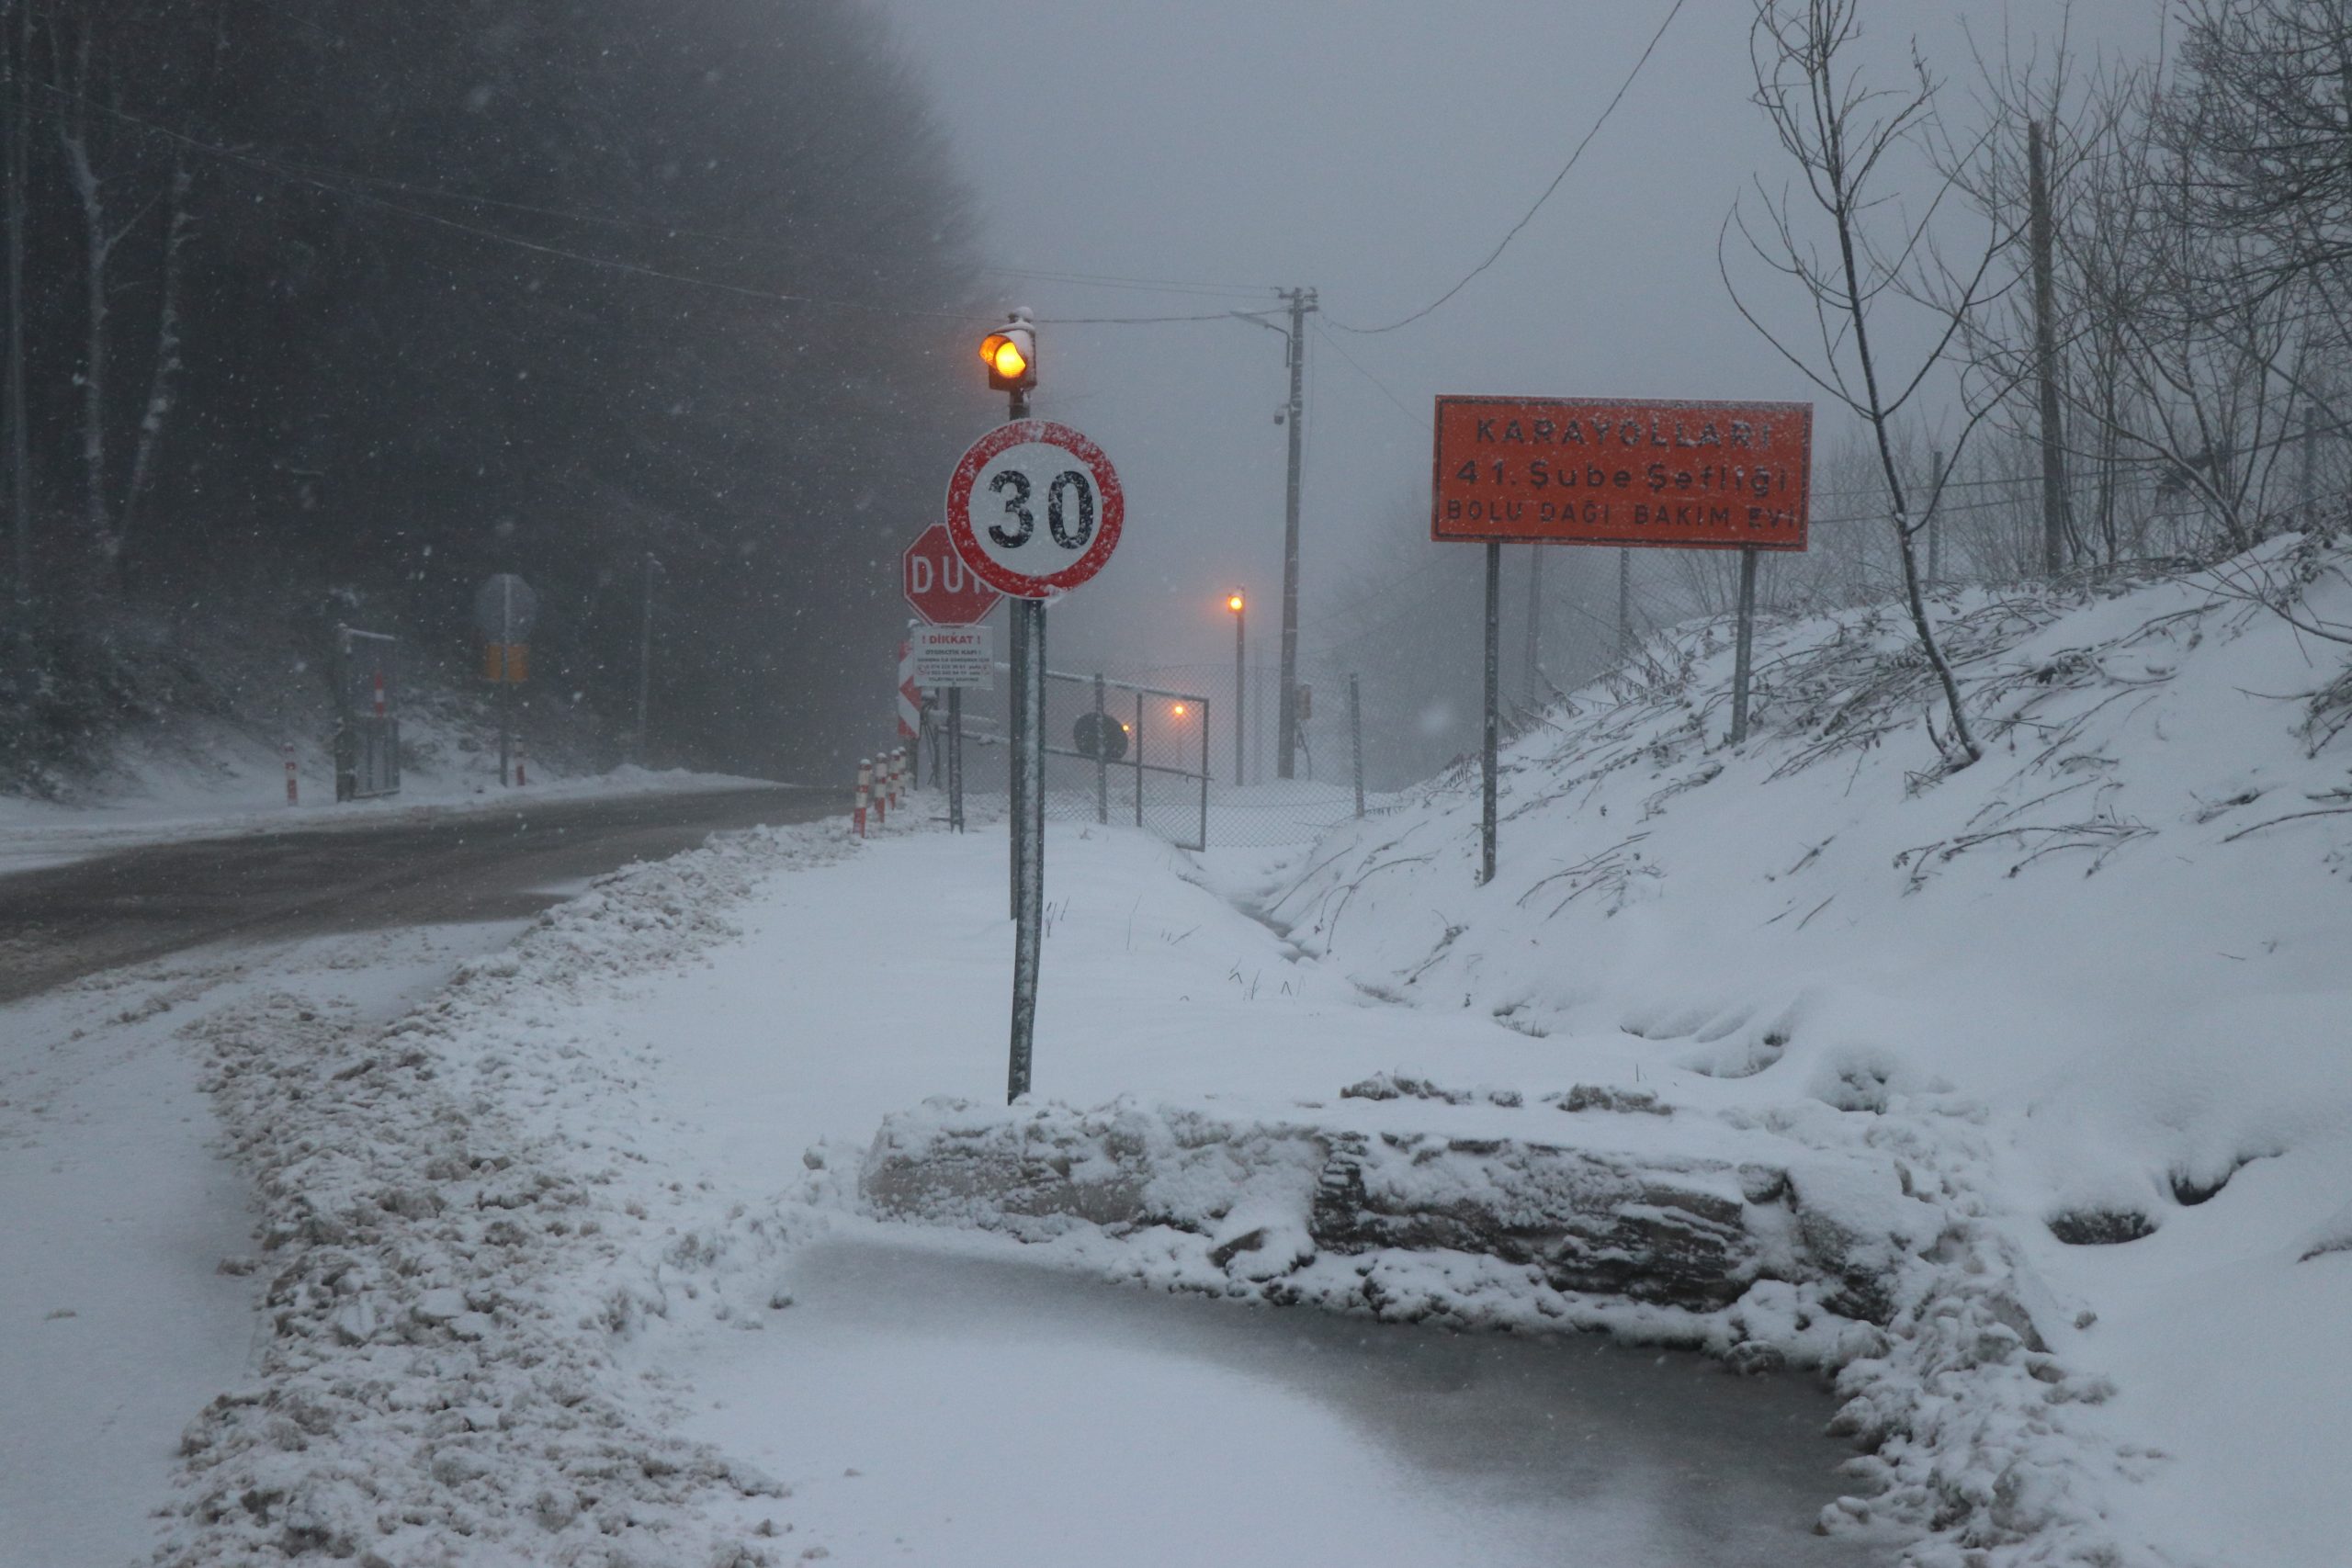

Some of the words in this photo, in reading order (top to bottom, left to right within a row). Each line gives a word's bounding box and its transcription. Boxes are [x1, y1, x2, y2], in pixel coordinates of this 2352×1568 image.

[1476, 418, 1770, 449] KARAYOLLARI
[1456, 459, 1518, 486] 41.
[1530, 460, 1632, 490] Şube
[989, 470, 1093, 549] 30
[1447, 499, 1522, 523] BOLU
[1540, 500, 1610, 525] DAĞI
[1634, 503, 1730, 527] BAKIM
[929, 633, 974, 645] DİKKAT
